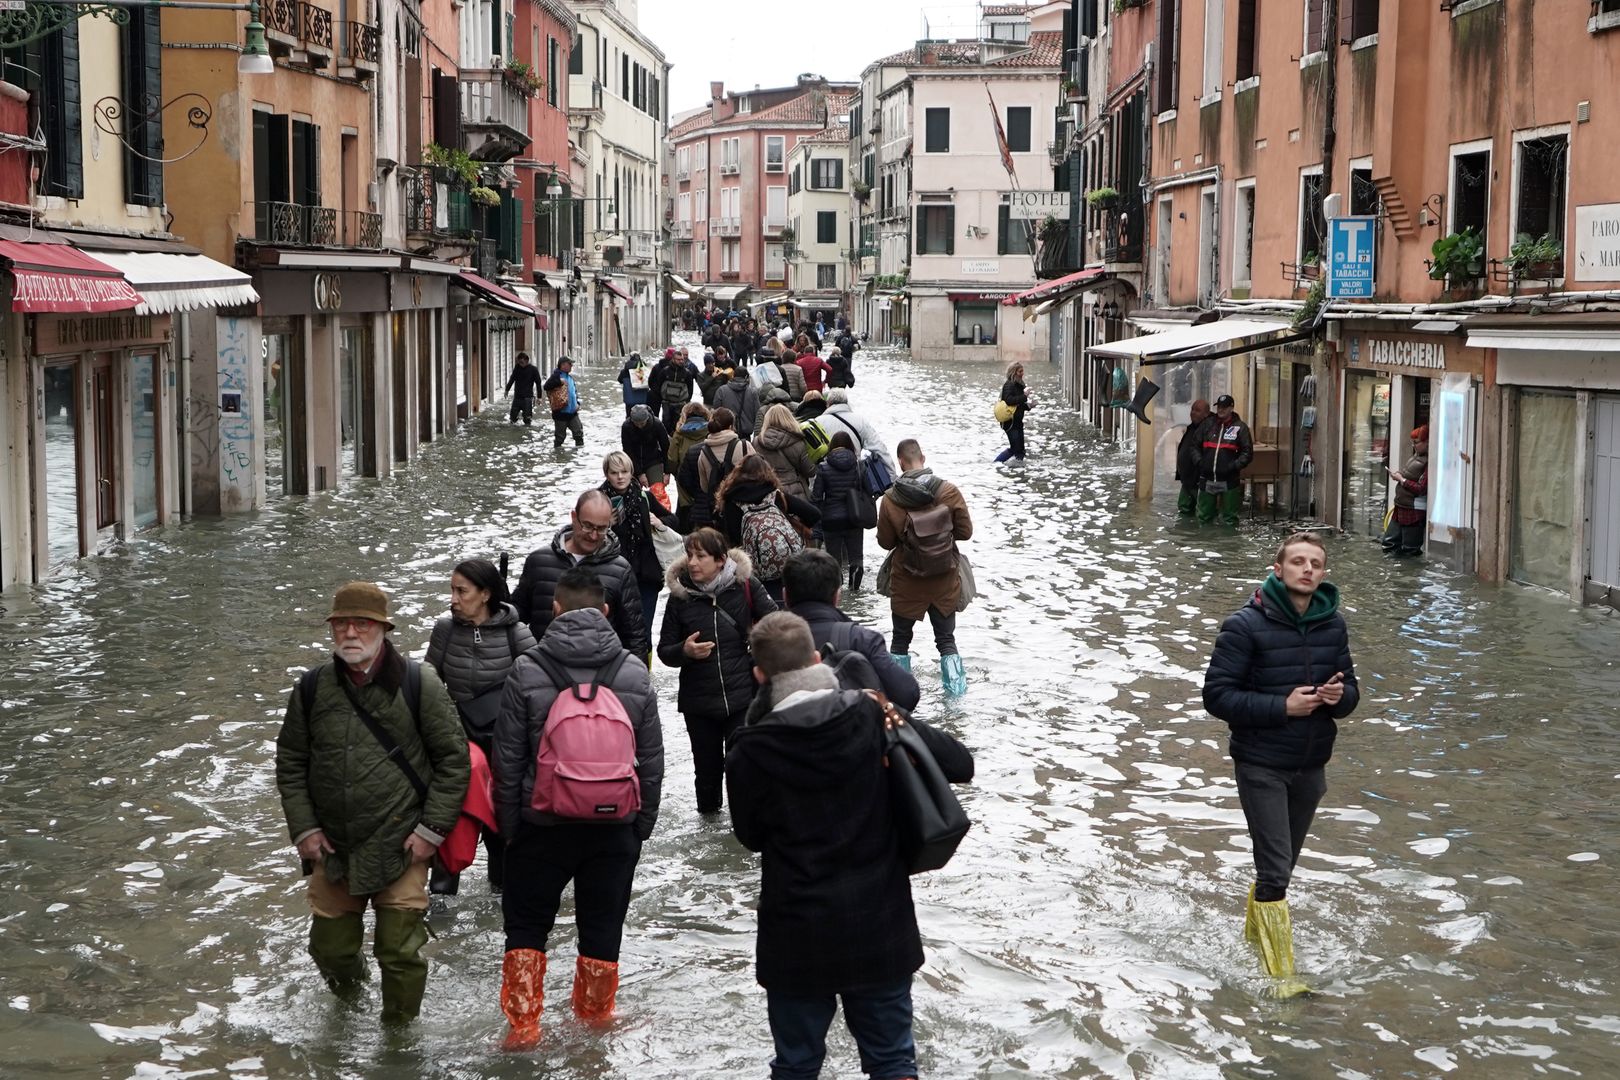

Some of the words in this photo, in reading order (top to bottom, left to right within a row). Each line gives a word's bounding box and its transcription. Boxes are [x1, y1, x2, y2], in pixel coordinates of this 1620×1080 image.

[1012, 192, 1069, 206] HOTEL
[1339, 222, 1367, 263] T
[1336, 269, 1369, 277] TABACCHI
[13, 273, 59, 308] TRATTORIA
[1368, 340, 1446, 369] TABACCHERIA
